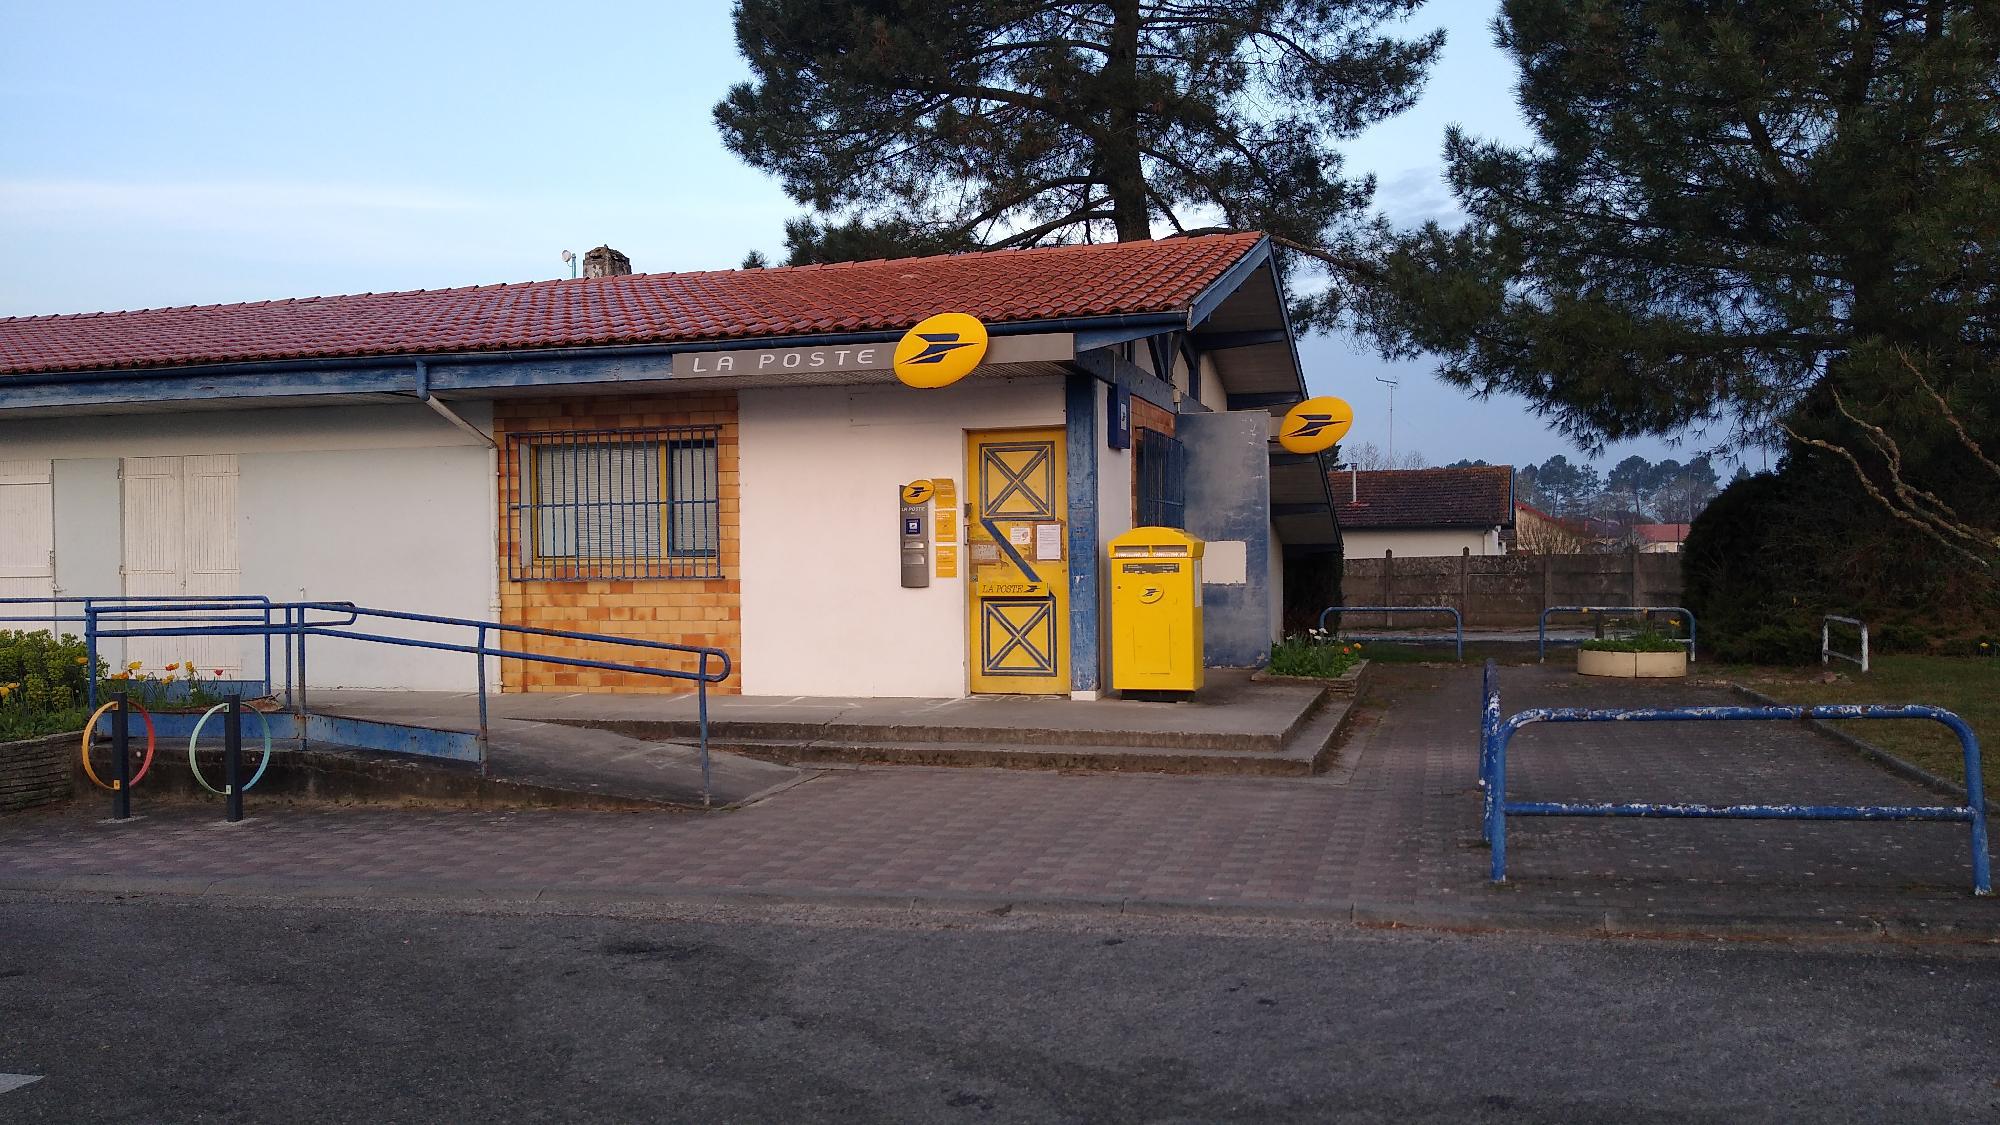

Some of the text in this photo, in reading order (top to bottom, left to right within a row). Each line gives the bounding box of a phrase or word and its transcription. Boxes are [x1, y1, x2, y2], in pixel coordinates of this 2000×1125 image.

[692, 349, 875, 372] LA POSTE
[982, 584, 1024, 593] LA POSTE
